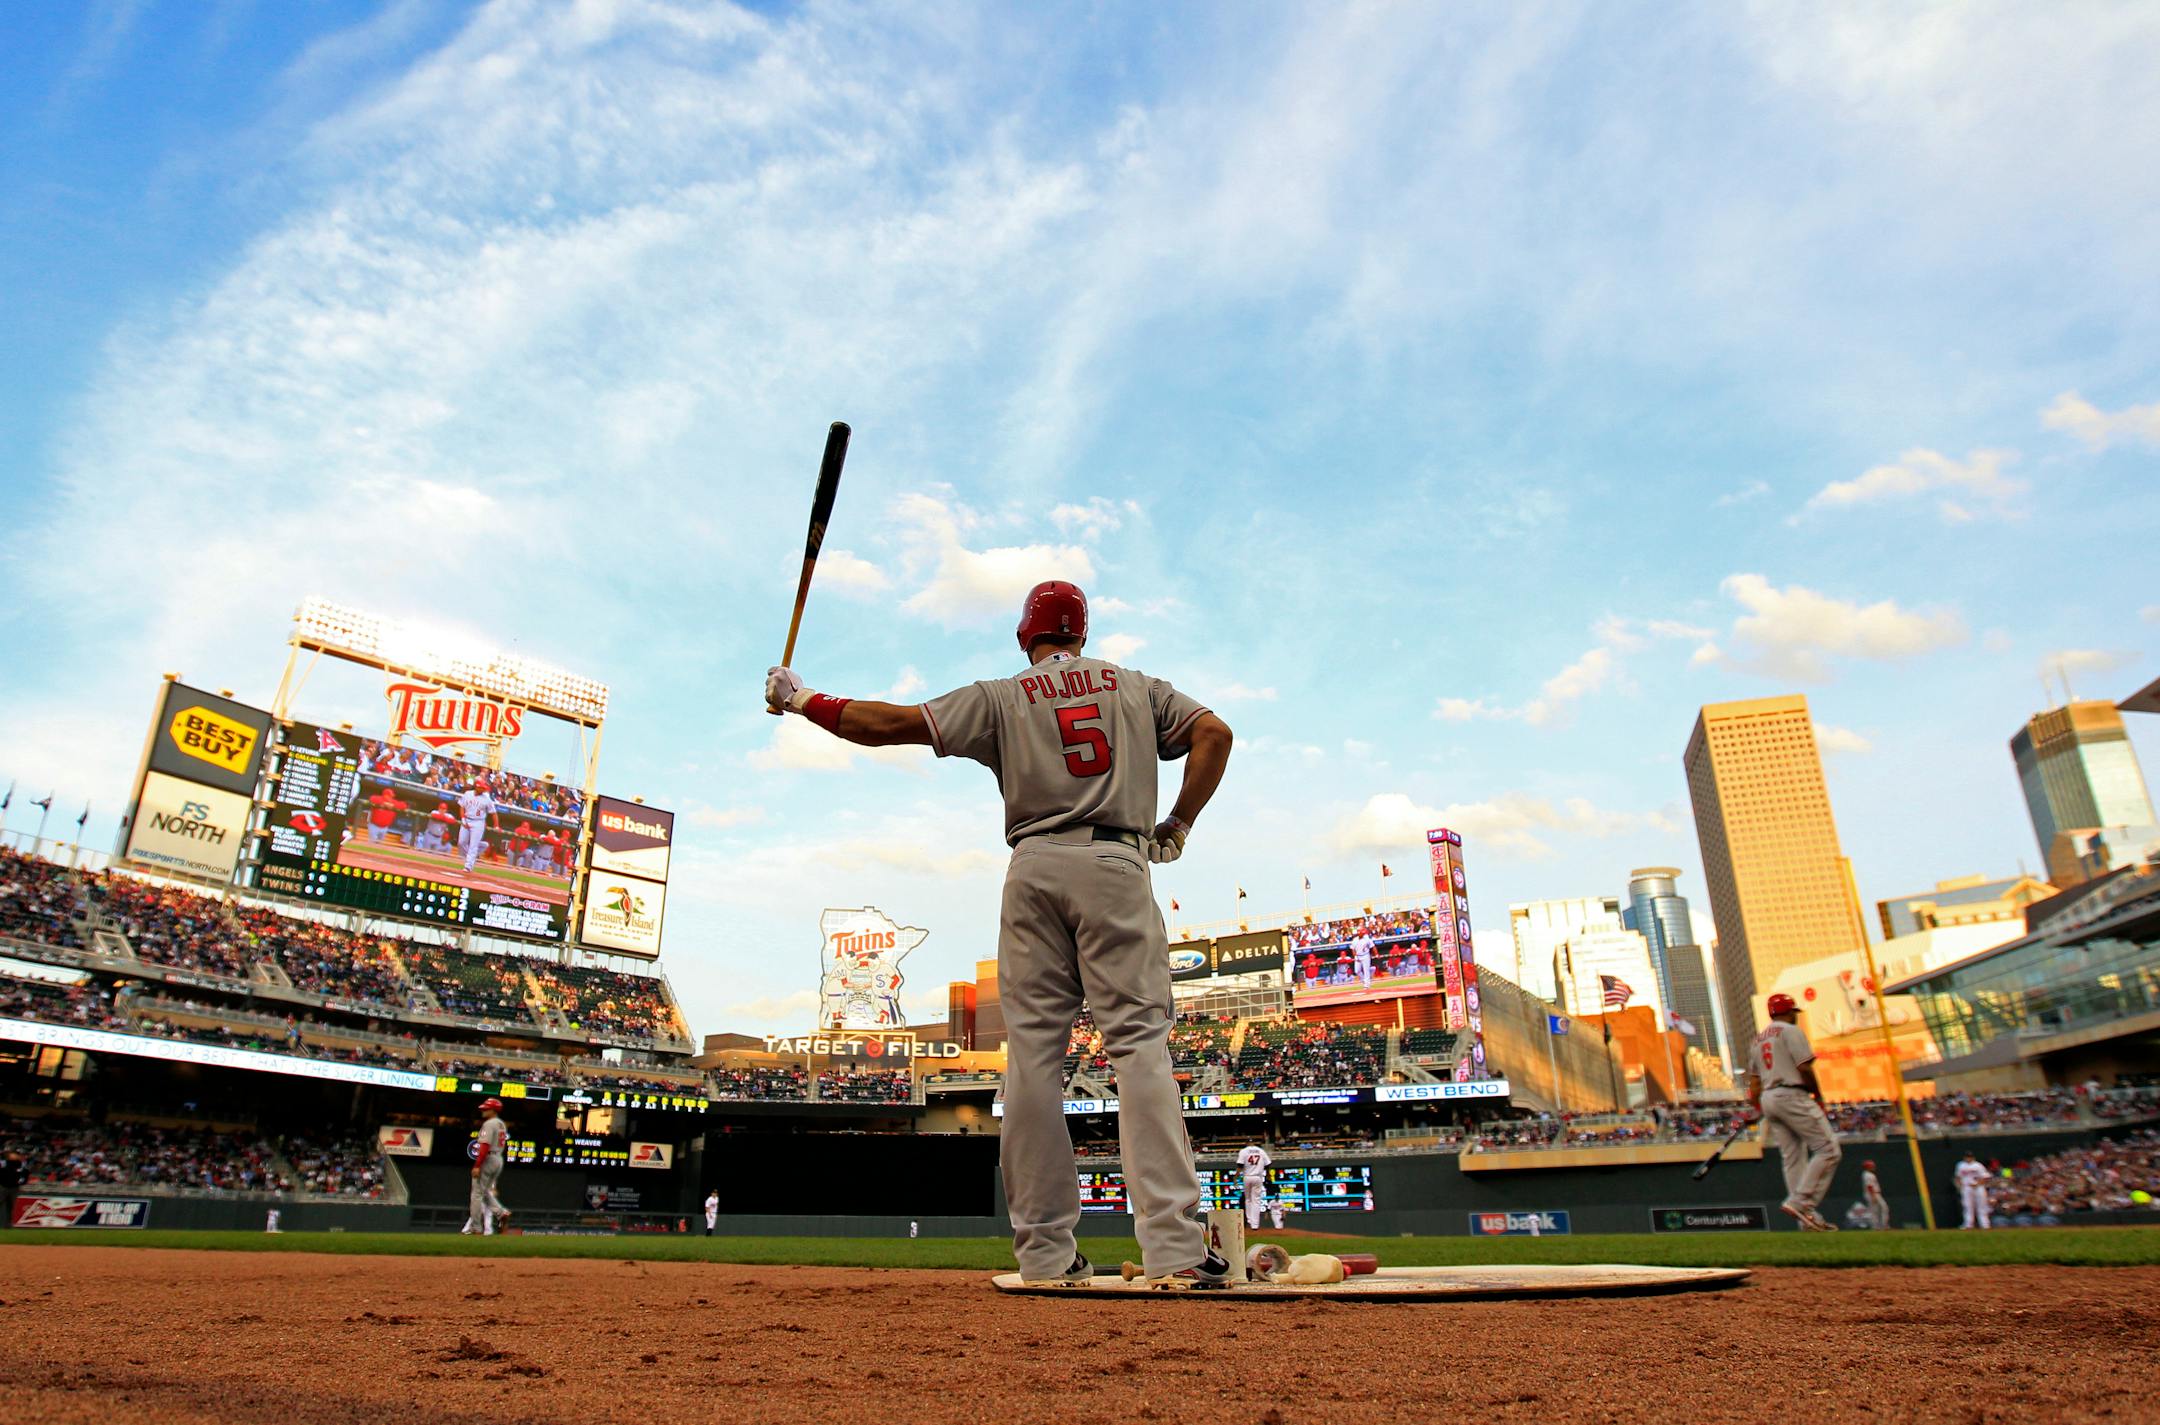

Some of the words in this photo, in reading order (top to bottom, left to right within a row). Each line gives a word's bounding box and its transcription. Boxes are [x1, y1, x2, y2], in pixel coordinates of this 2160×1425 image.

[1020, 668, 1118, 705] PUJOLS
[385, 683, 524, 738] Twins
[186, 714, 251, 749] BEST
[184, 731, 241, 760] BUY
[1054, 702, 1112, 778] 5
[294, 759, 318, 769] PUJOLS
[288, 785, 311, 794] WELLS
[181, 800, 209, 821] FS
[150, 812, 227, 844] NORTH
[311, 860, 318, 870] 1
[321, 862, 330, 872] 2
[331, 864, 341, 874] 3
[342, 866, 351, 876] 4
[352, 868, 362, 878] 5
[363, 870, 373, 879] 6
[374, 872, 382, 880] 7
[383, 874, 393, 883] 8
[393, 876, 403, 885] 9
[406, 878, 416, 887] R
[418, 880, 427, 889] H
[430, 882, 438, 891] E
[262, 864, 304, 880] ANGELS
[308, 872, 315, 881] 1
[319, 874, 327, 883] 0
[405, 890, 412, 898] 1
[416, 892, 424, 901] 2
[428, 894, 436, 902] 0
[440, 896, 446, 904] 1
[261, 878, 302, 893] TWINS
[304, 885, 314, 894] 0
[316, 886, 325, 896] 0
[402, 902, 411, 911] 0
[414, 904, 422, 913] 0
[426, 906, 434, 915] 0
[437, 908, 445, 917] 0
[460, 887, 470, 899] 3
[458, 899, 468, 910] 2
[1455, 895, 1468, 912] VS
[458, 910, 465, 922] 1
[591, 907, 624, 925] Treasure
[631, 915, 655, 931] Island
[830, 929, 896, 959] Twins
[1235, 945, 1279, 960] DELTA
[875, 974, 886, 988] S
[36, 1028, 104, 1049] BRINGS
[111, 1037, 152, 1053] OUT
[159, 1043, 194, 1058] OUR
[304, 1062, 329, 1077] THE
[335, 1066, 375, 1081] SILVER
[763, 1036, 863, 1056] TARGET
[888, 1041, 961, 1058] FIELD
[1762, 1042, 1773, 1070] 6
[1220, 1093, 1255, 1102] DIAMOND
[1387, 1087, 1439, 1099] WEST
[1444, 1084, 1499, 1096] BEND
[1063, 1102, 1095, 1112] END
[1183, 1102, 1189, 1110] 2
[1225, 1100, 1250, 1108] NOTES
[575, 1139, 602, 1147] WEAVER
[1248, 1155, 1261, 1166] 47
[1078, 1173, 1093, 1181] BOS
[1308, 1174, 1324, 1182] LAD
[1685, 1215, 1749, 1226] CenturyLink
[1211, 1222, 1222, 1249] A
